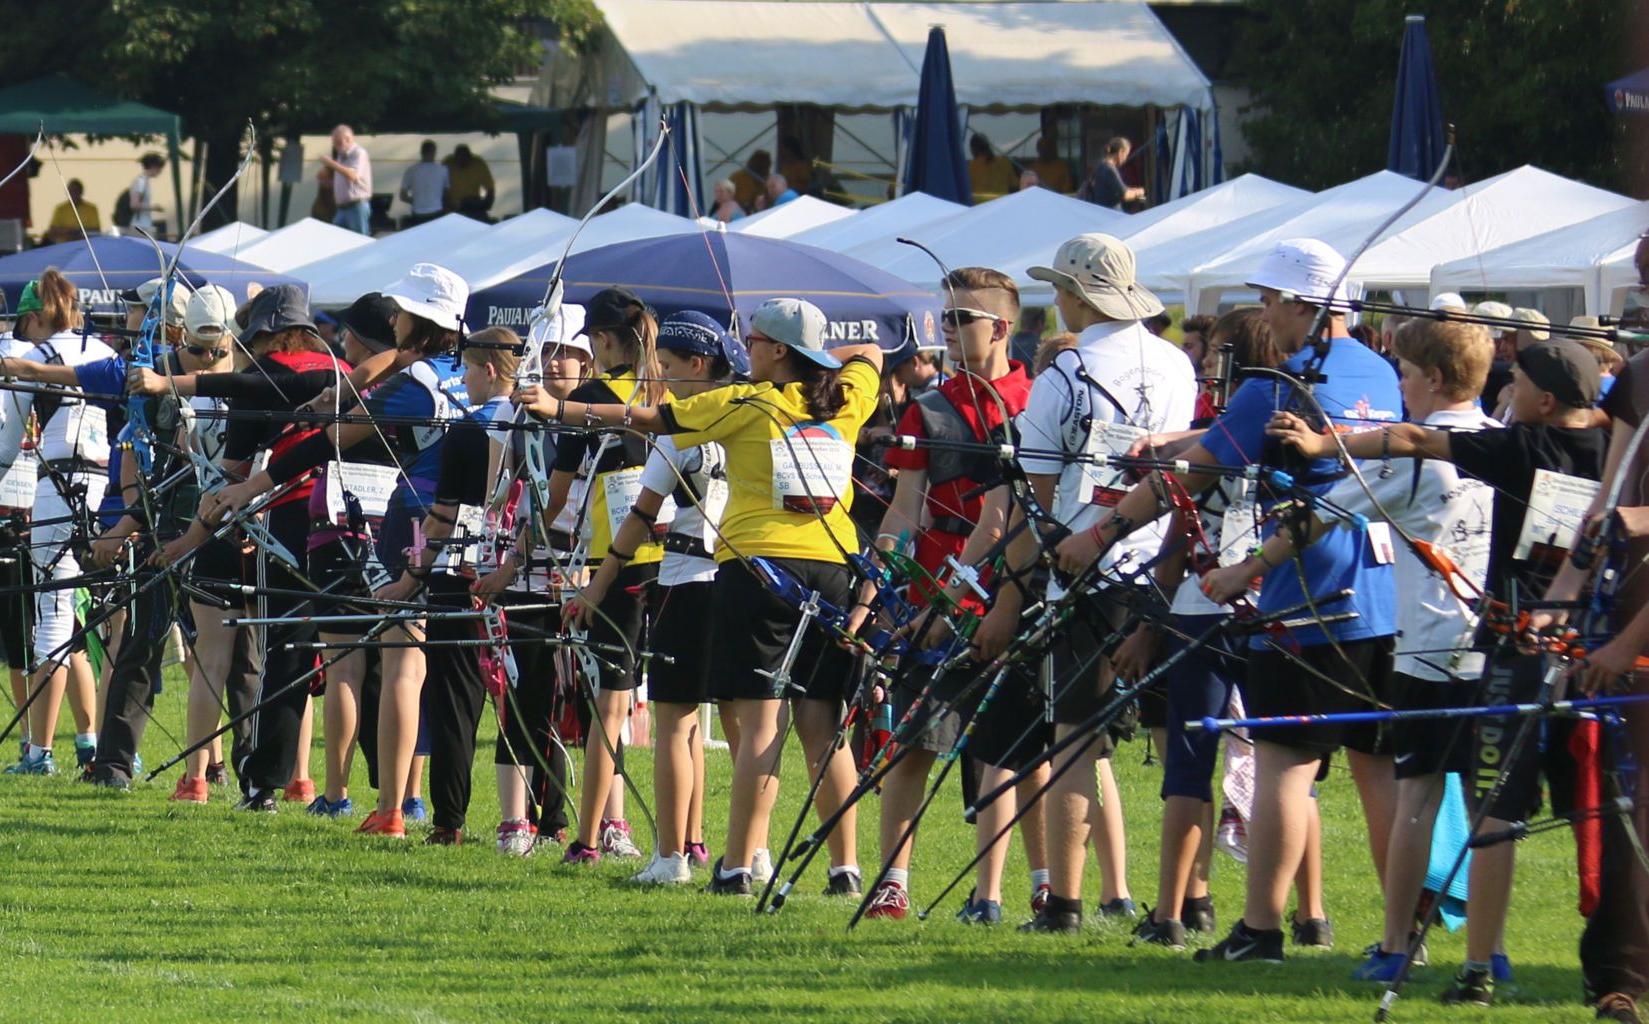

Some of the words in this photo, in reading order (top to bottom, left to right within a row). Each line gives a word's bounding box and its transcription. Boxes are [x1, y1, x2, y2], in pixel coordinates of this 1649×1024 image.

[1072, 389, 1085, 435] EASTON
[779, 482, 790, 490] SB
[611, 506, 629, 515] BCVS
[1480, 727, 1503, 764] DO
